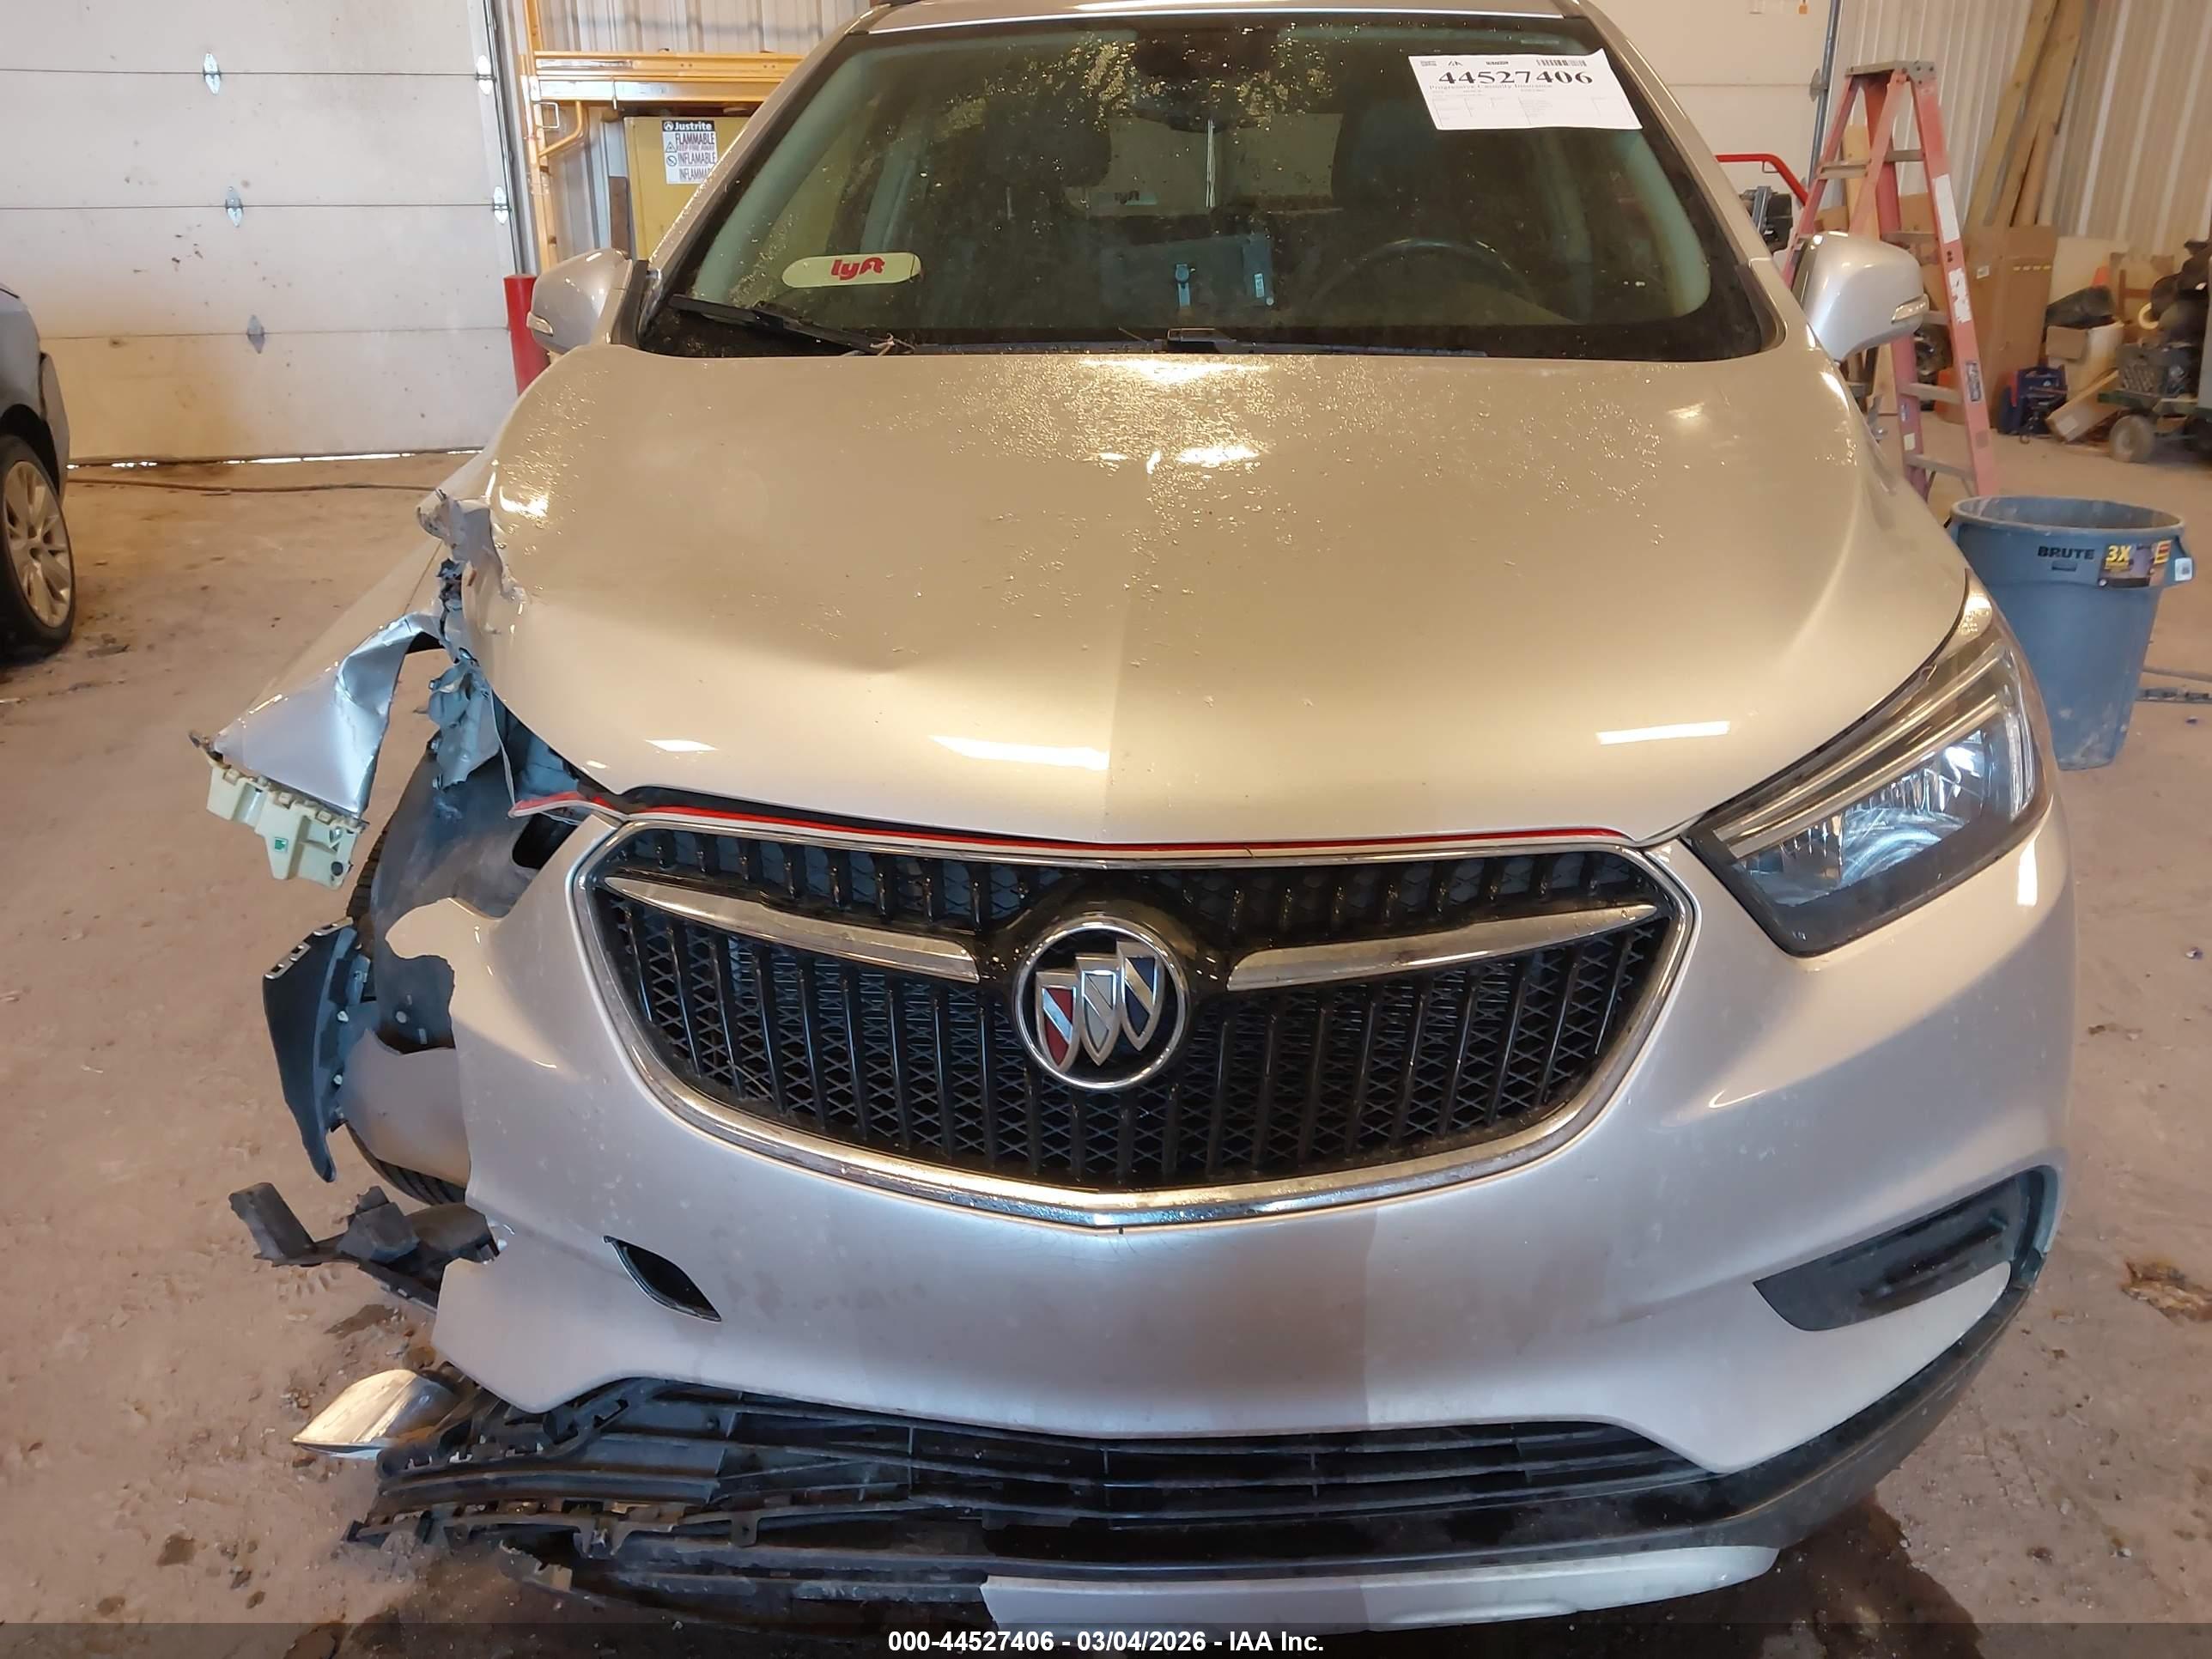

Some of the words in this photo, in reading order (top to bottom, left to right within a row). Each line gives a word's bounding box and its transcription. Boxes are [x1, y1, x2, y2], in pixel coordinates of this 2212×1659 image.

[1438, 70, 1593, 84] 44527406
[675, 122, 712, 131] Justrite
[676, 133, 714, 144] FLAMMABLE
[678, 152, 715, 164] INFLAMABLE
[830, 257, 885, 281] lyft
[2038, 546, 2094, 560] BRUTE
[2106, 545, 2131, 562] 3X
